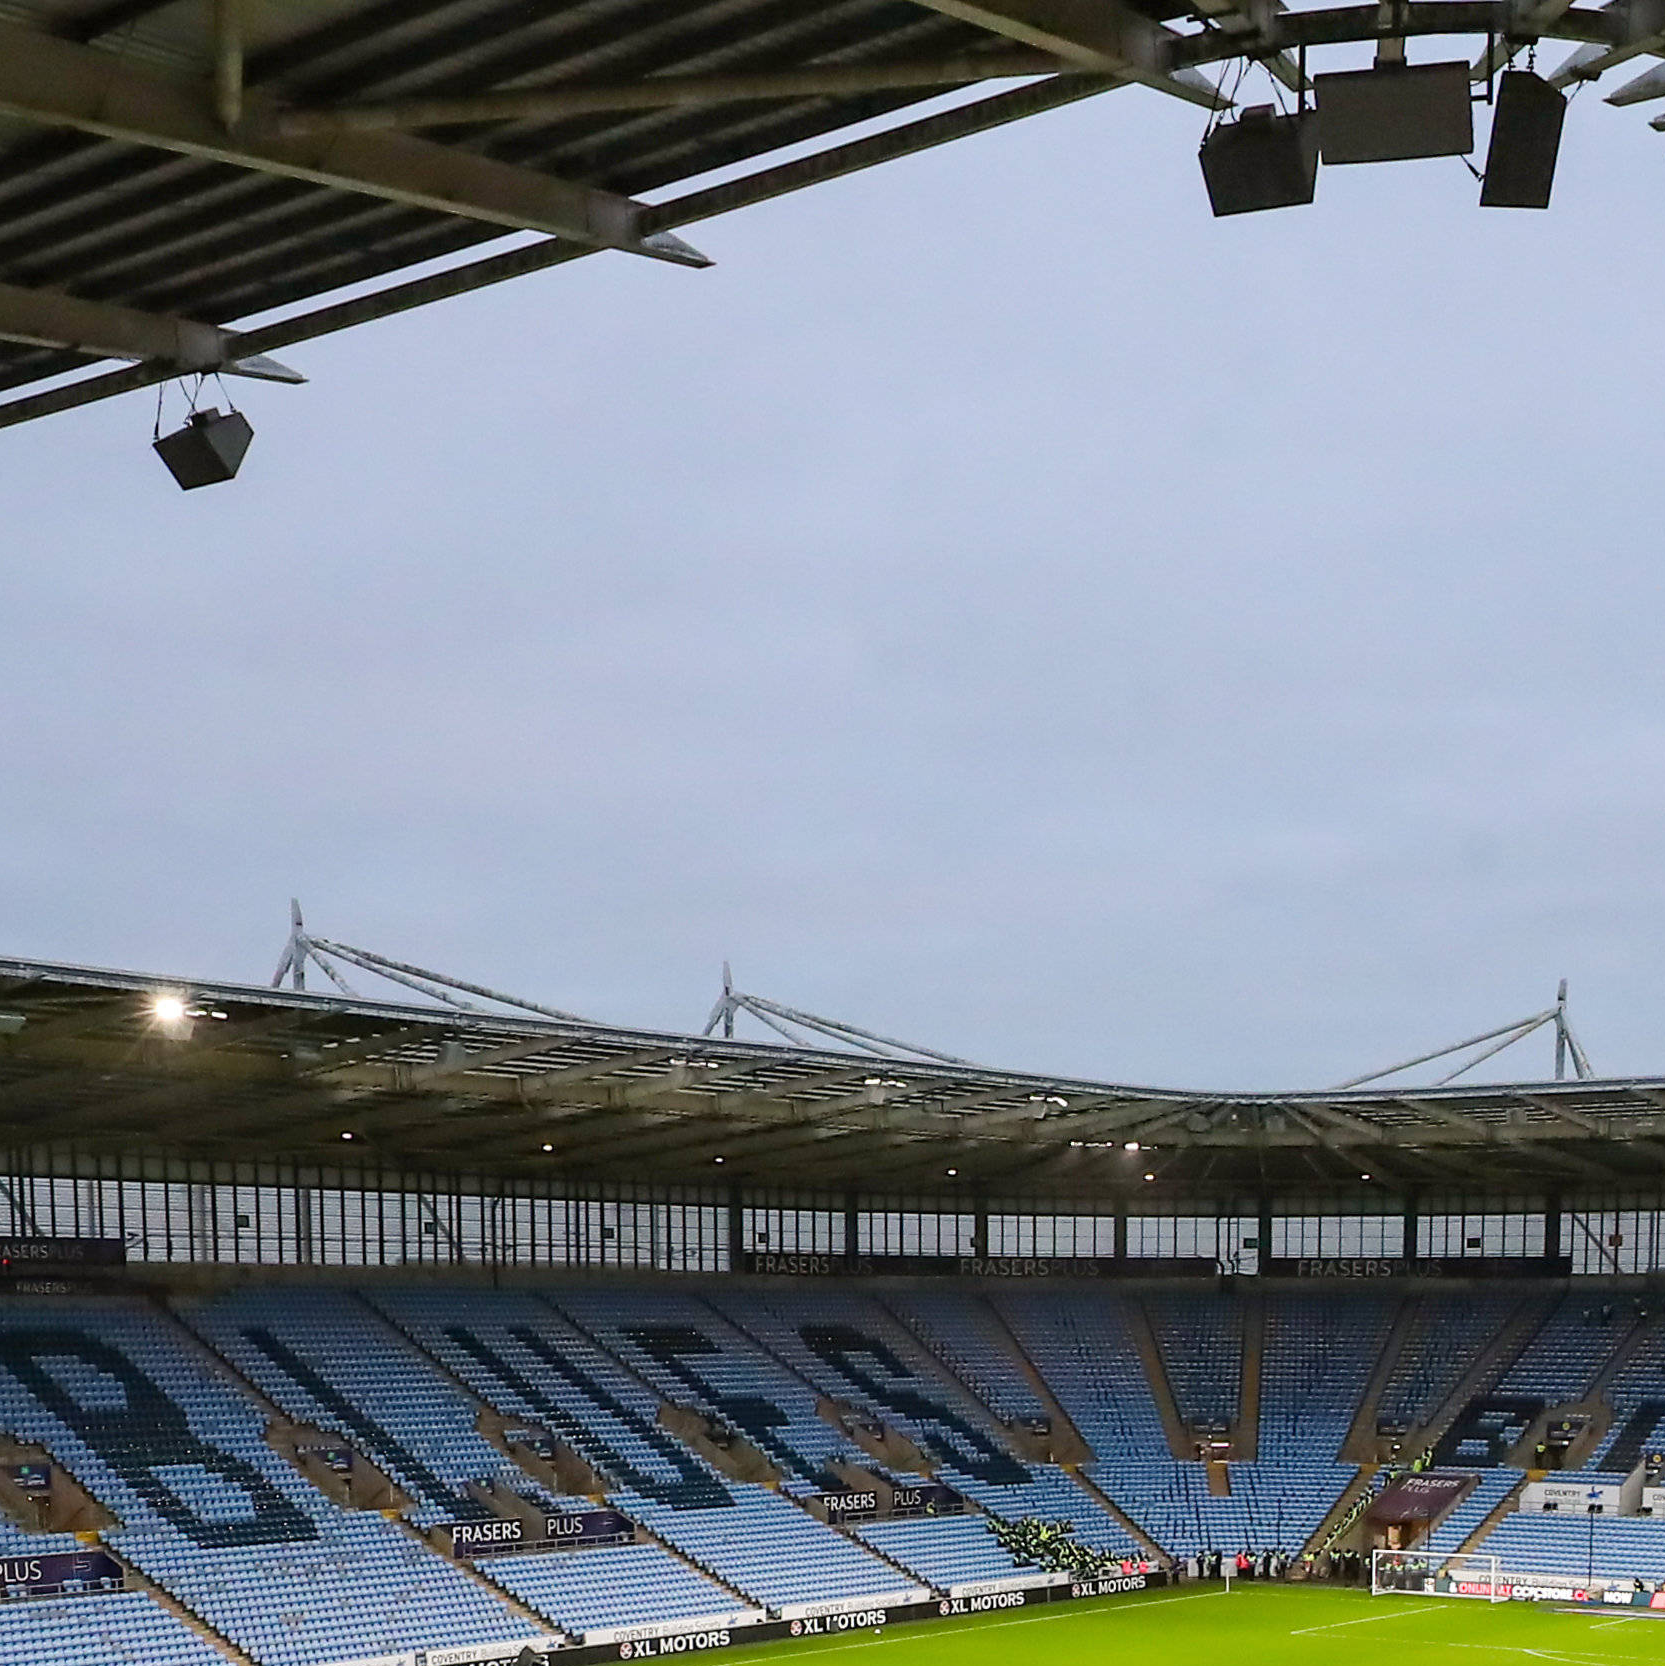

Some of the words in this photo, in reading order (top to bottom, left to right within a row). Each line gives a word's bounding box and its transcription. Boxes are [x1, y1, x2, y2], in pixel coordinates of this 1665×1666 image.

[1406, 1478, 1460, 1489] FRASERS
[823, 1493, 876, 1511] FRASERS
[893, 1489, 921, 1505] PLUS
[452, 1519, 522, 1543] FRASERS
[546, 1515, 584, 1535] PLUS
[1080, 1582, 1096, 1597] XL
[1097, 1575, 1146, 1595] MOTORS
[951, 1599, 968, 1614] XL
[970, 1591, 1025, 1611] MOTORS
[1604, 1592, 1632, 1604] NOW
[805, 1602, 844, 1617] COVENTRY
[614, 1627, 659, 1642] COVENTRY
[802, 1619, 823, 1636] XL
[633, 1640, 657, 1658] XL
[660, 1630, 731, 1654] MOTORS
[431, 1651, 478, 1665] COVENTRY
